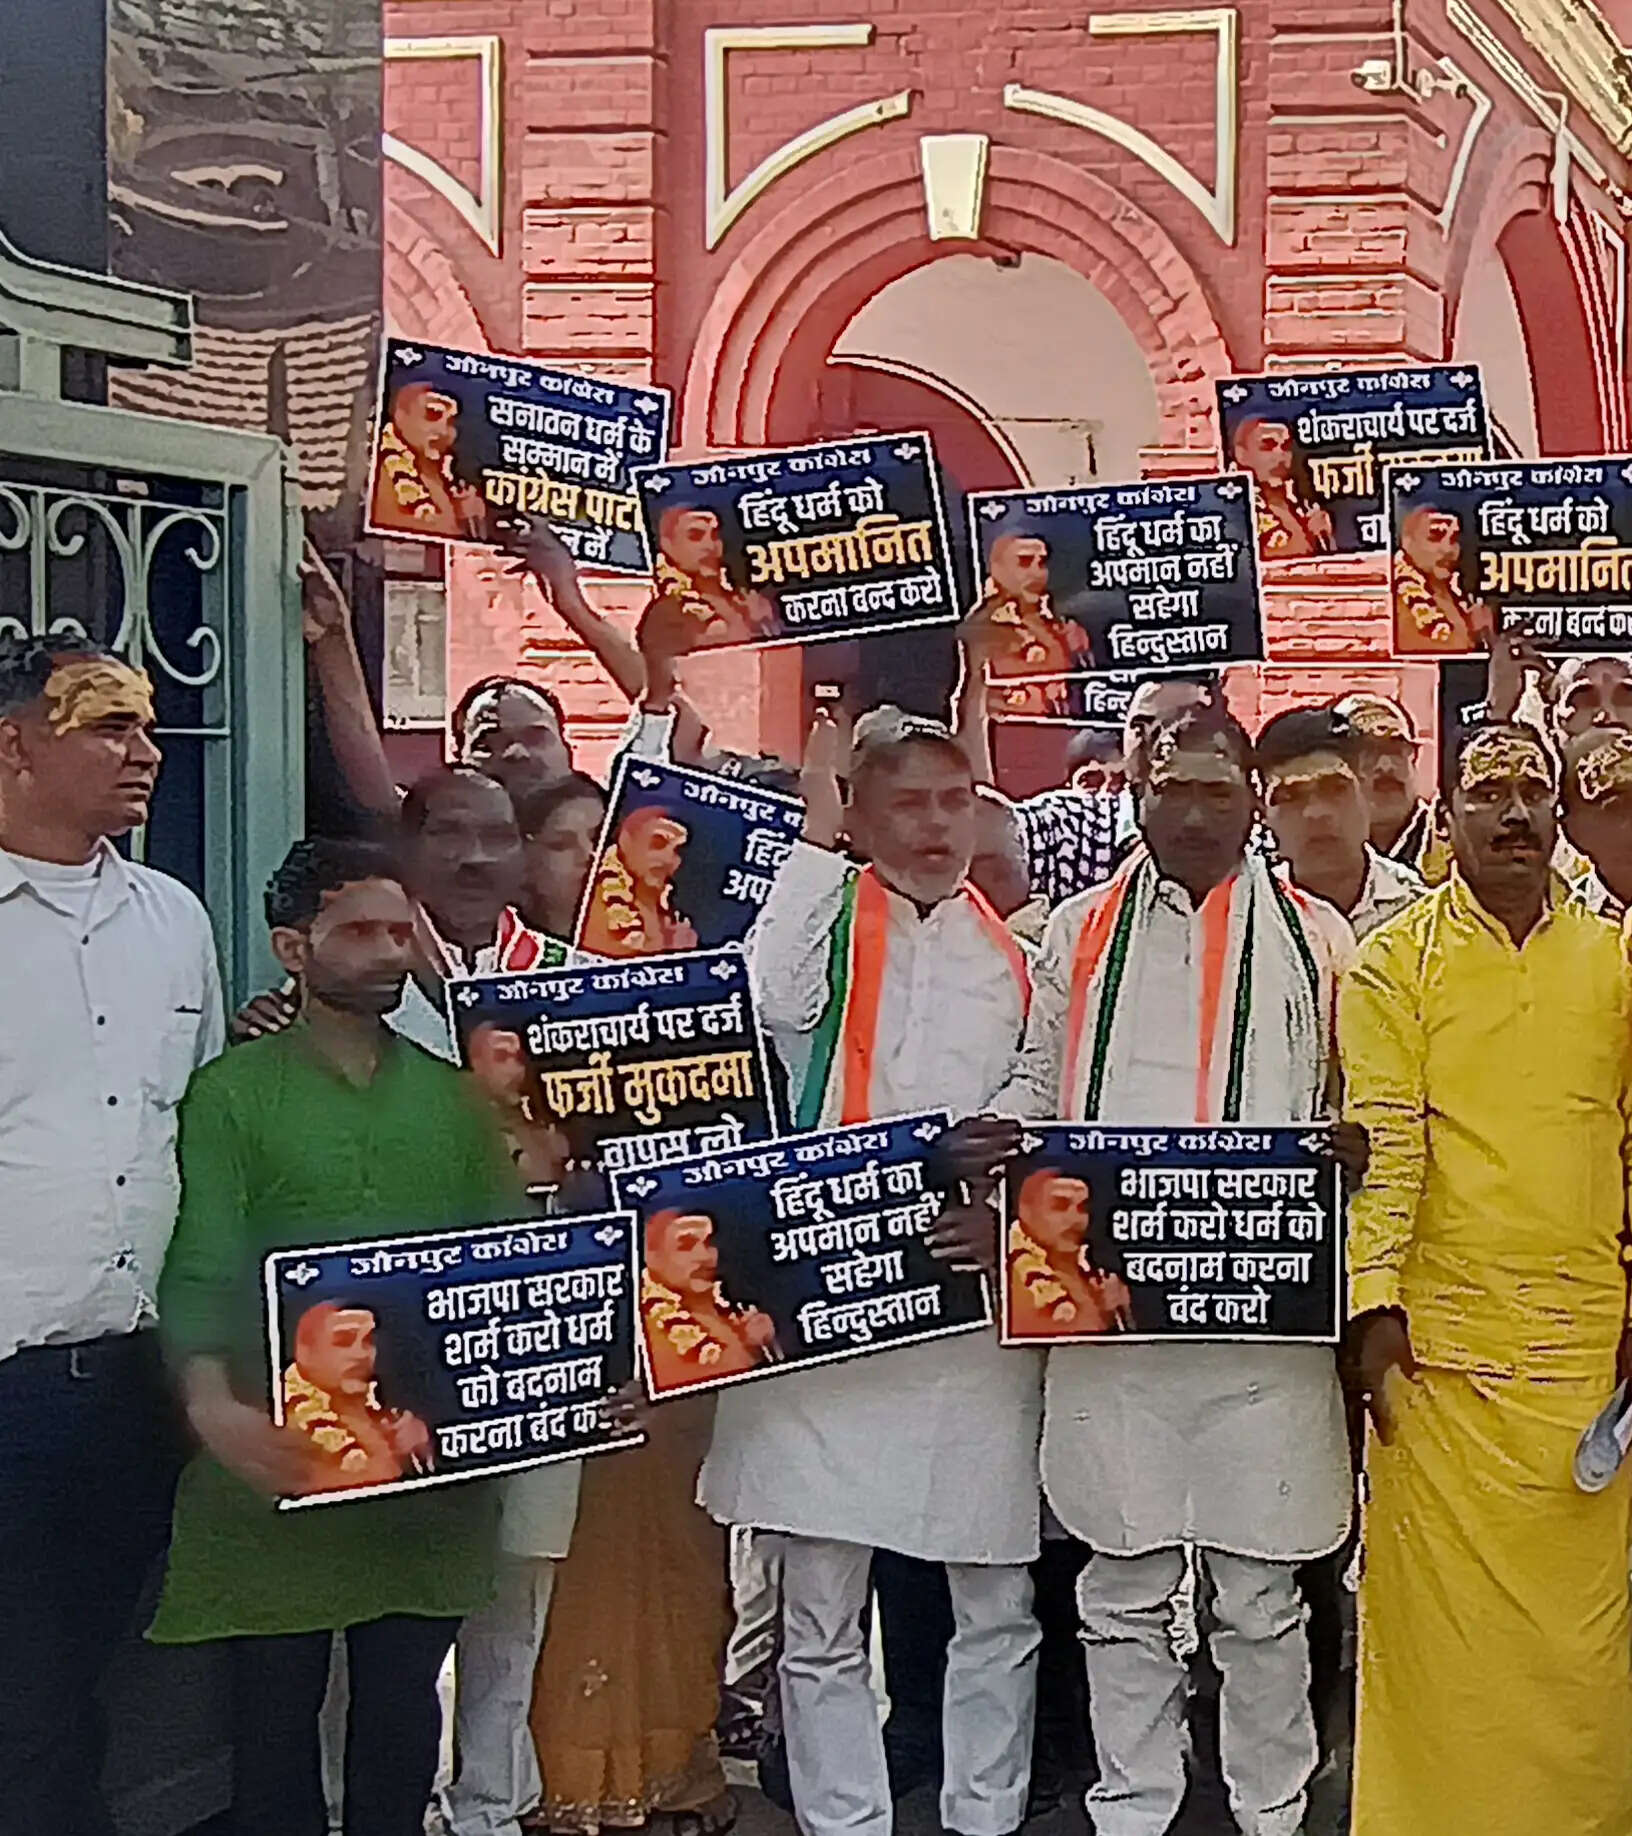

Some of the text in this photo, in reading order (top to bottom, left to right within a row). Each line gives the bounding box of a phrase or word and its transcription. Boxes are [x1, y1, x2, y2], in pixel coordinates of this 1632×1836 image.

[488, 395, 656, 454] सनातन धर्म के
[1298, 398, 1477, 441] शंकराचार्य पर दर्ज
[501, 435, 623, 483] सम्मान में
[483, 466, 581, 519] कांग्रेस
[738, 477, 884, 533] हिंदू धर्म को
[1094, 510, 1222, 558] हिंदू धर्म का
[1479, 496, 1609, 544] हिंदू धर्म को
[747, 514, 933, 583] अपमानित
[1090, 544, 1238, 587] अपमान नहीं
[781, 586, 848, 622] करना
[899, 566, 942, 606] करो
[1129, 586, 1199, 620] सहेगा
[1108, 624, 1229, 663] हिन्दुस्तान
[1565, 605, 1608, 637] बन्द
[528, 992, 743, 1054] शंकराचार्य पर दर्ज
[541, 1051, 753, 1126] फर्जी मुकदमा
[694, 1113, 744, 1151] लो
[770, 1160, 924, 1222] हिंदू धर्म का
[1121, 1168, 1318, 1200] भाजपा सरकार
[771, 1191, 944, 1262] अपमान नहीं
[1113, 1201, 1327, 1242] शर्म करो धर्म को
[427, 1264, 625, 1321] भाजपा सरकार
[821, 1250, 904, 1294] सहेगा
[1123, 1252, 1312, 1283] बदनाम करना
[797, 1285, 941, 1343] हिन्दुस्तान
[1167, 1284, 1270, 1324] बंद करो
[445, 1300, 617, 1366] शर्म करो धर्म
[458, 1356, 604, 1409] को बदनाम
[437, 1414, 524, 1459] करना
[526, 1401, 571, 1443] बंद
